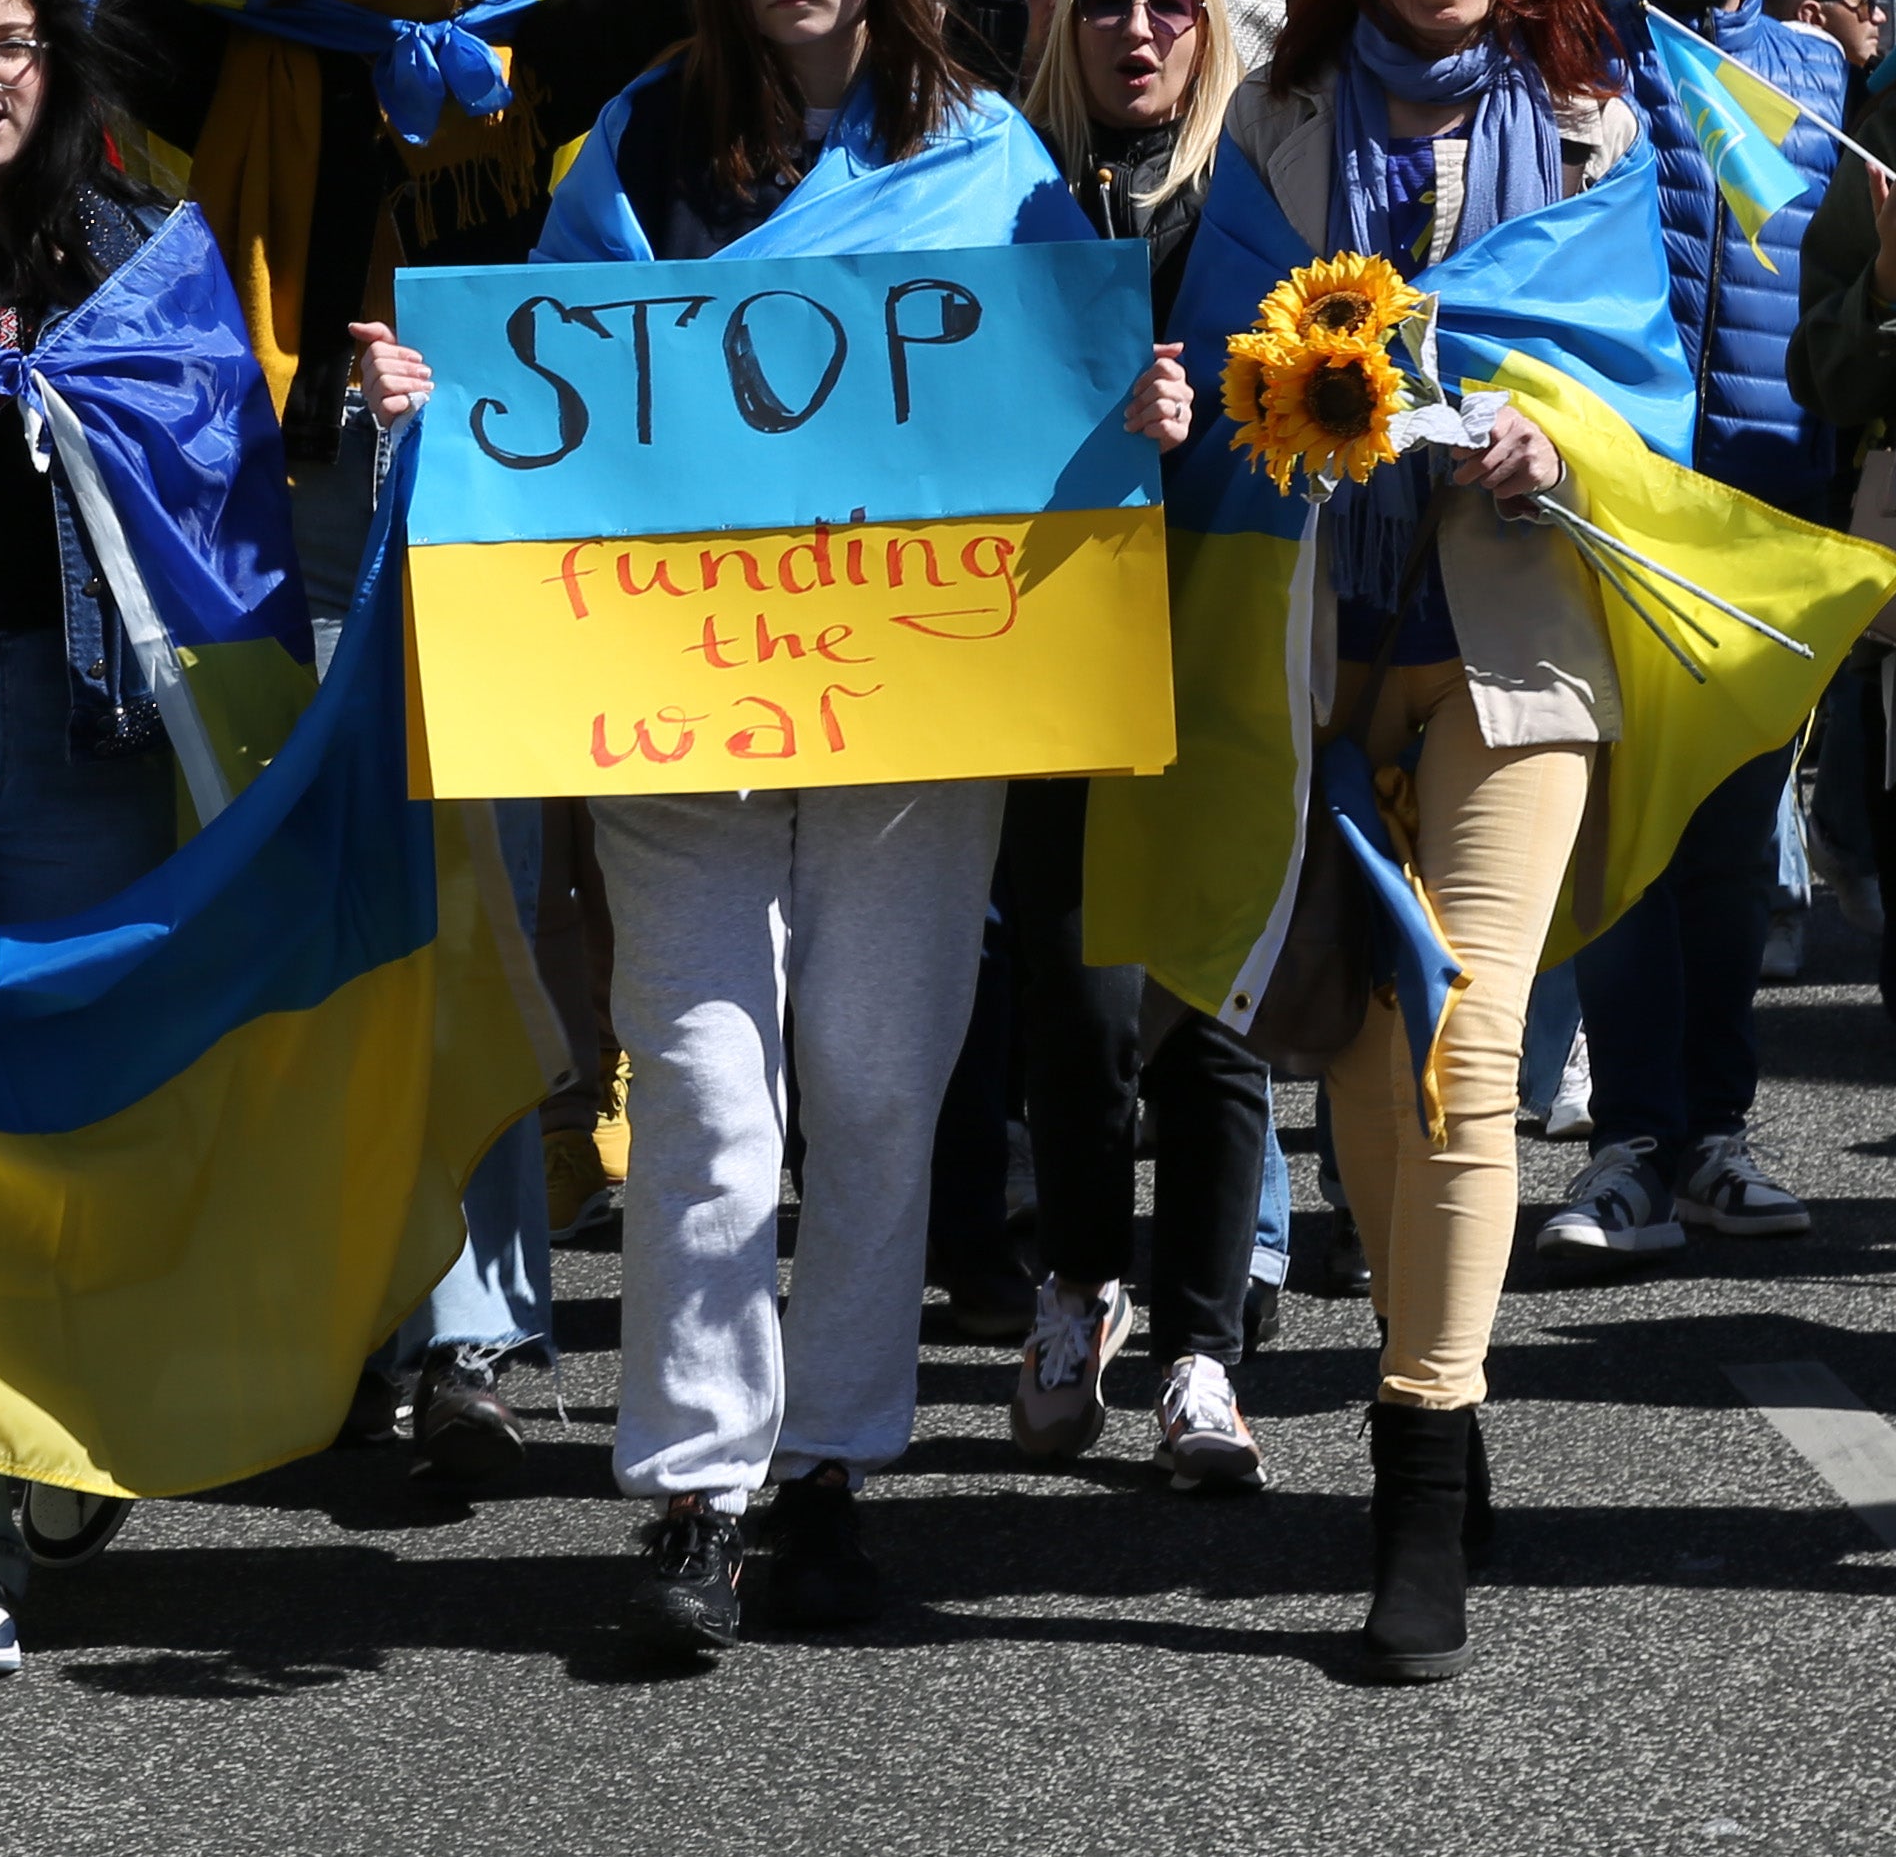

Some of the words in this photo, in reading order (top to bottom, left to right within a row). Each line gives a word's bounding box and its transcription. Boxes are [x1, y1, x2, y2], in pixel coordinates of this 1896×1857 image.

[468, 277, 983, 471] STOP
[541, 505, 1019, 640] funding
[682, 612, 875, 669] the
[590, 684, 885, 770] war
